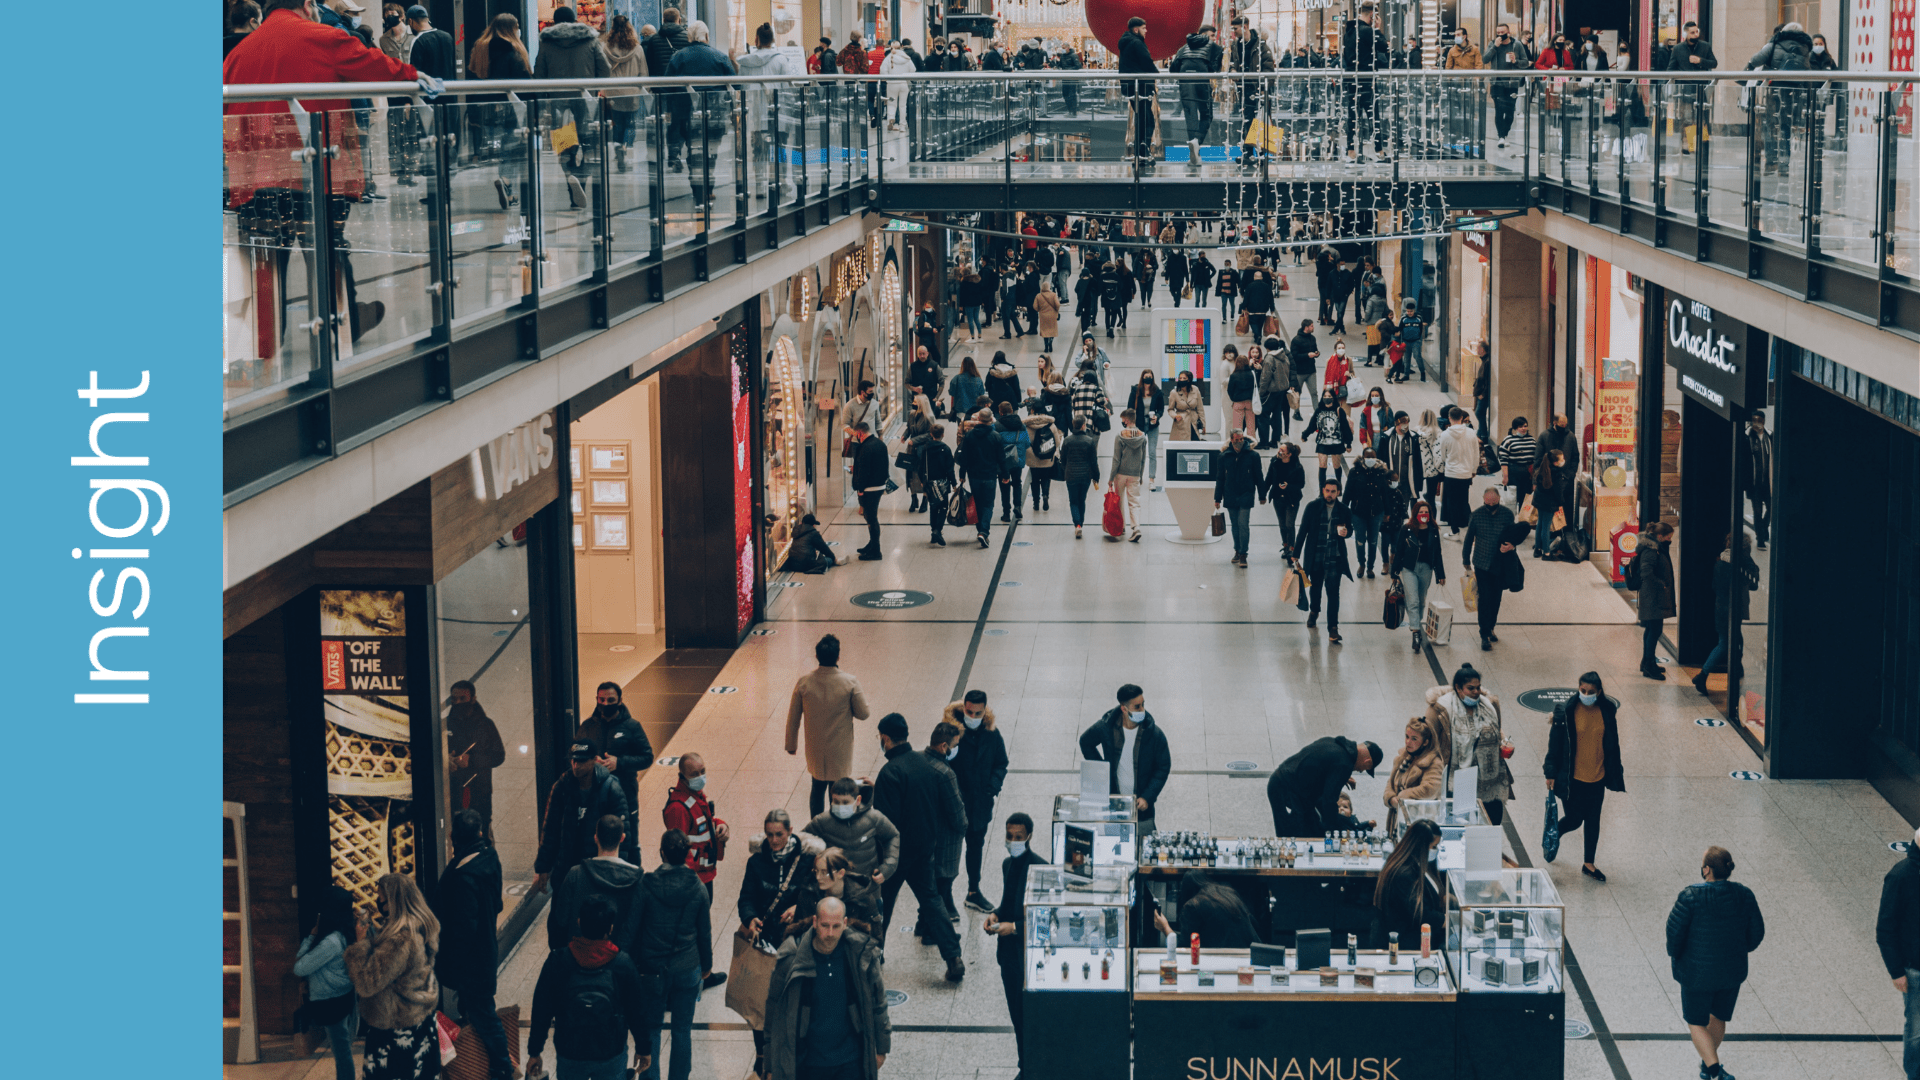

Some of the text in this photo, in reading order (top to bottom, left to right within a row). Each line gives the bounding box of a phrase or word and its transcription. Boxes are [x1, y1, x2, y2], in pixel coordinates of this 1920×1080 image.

[1690, 300, 1712, 323] HOTEL
[1604, 396, 1629, 404] NOW
[1600, 405, 1633, 413] UP TO
[350, 659, 382, 673] THE
[1186, 1056, 1402, 1080] SUNNAMUSK
